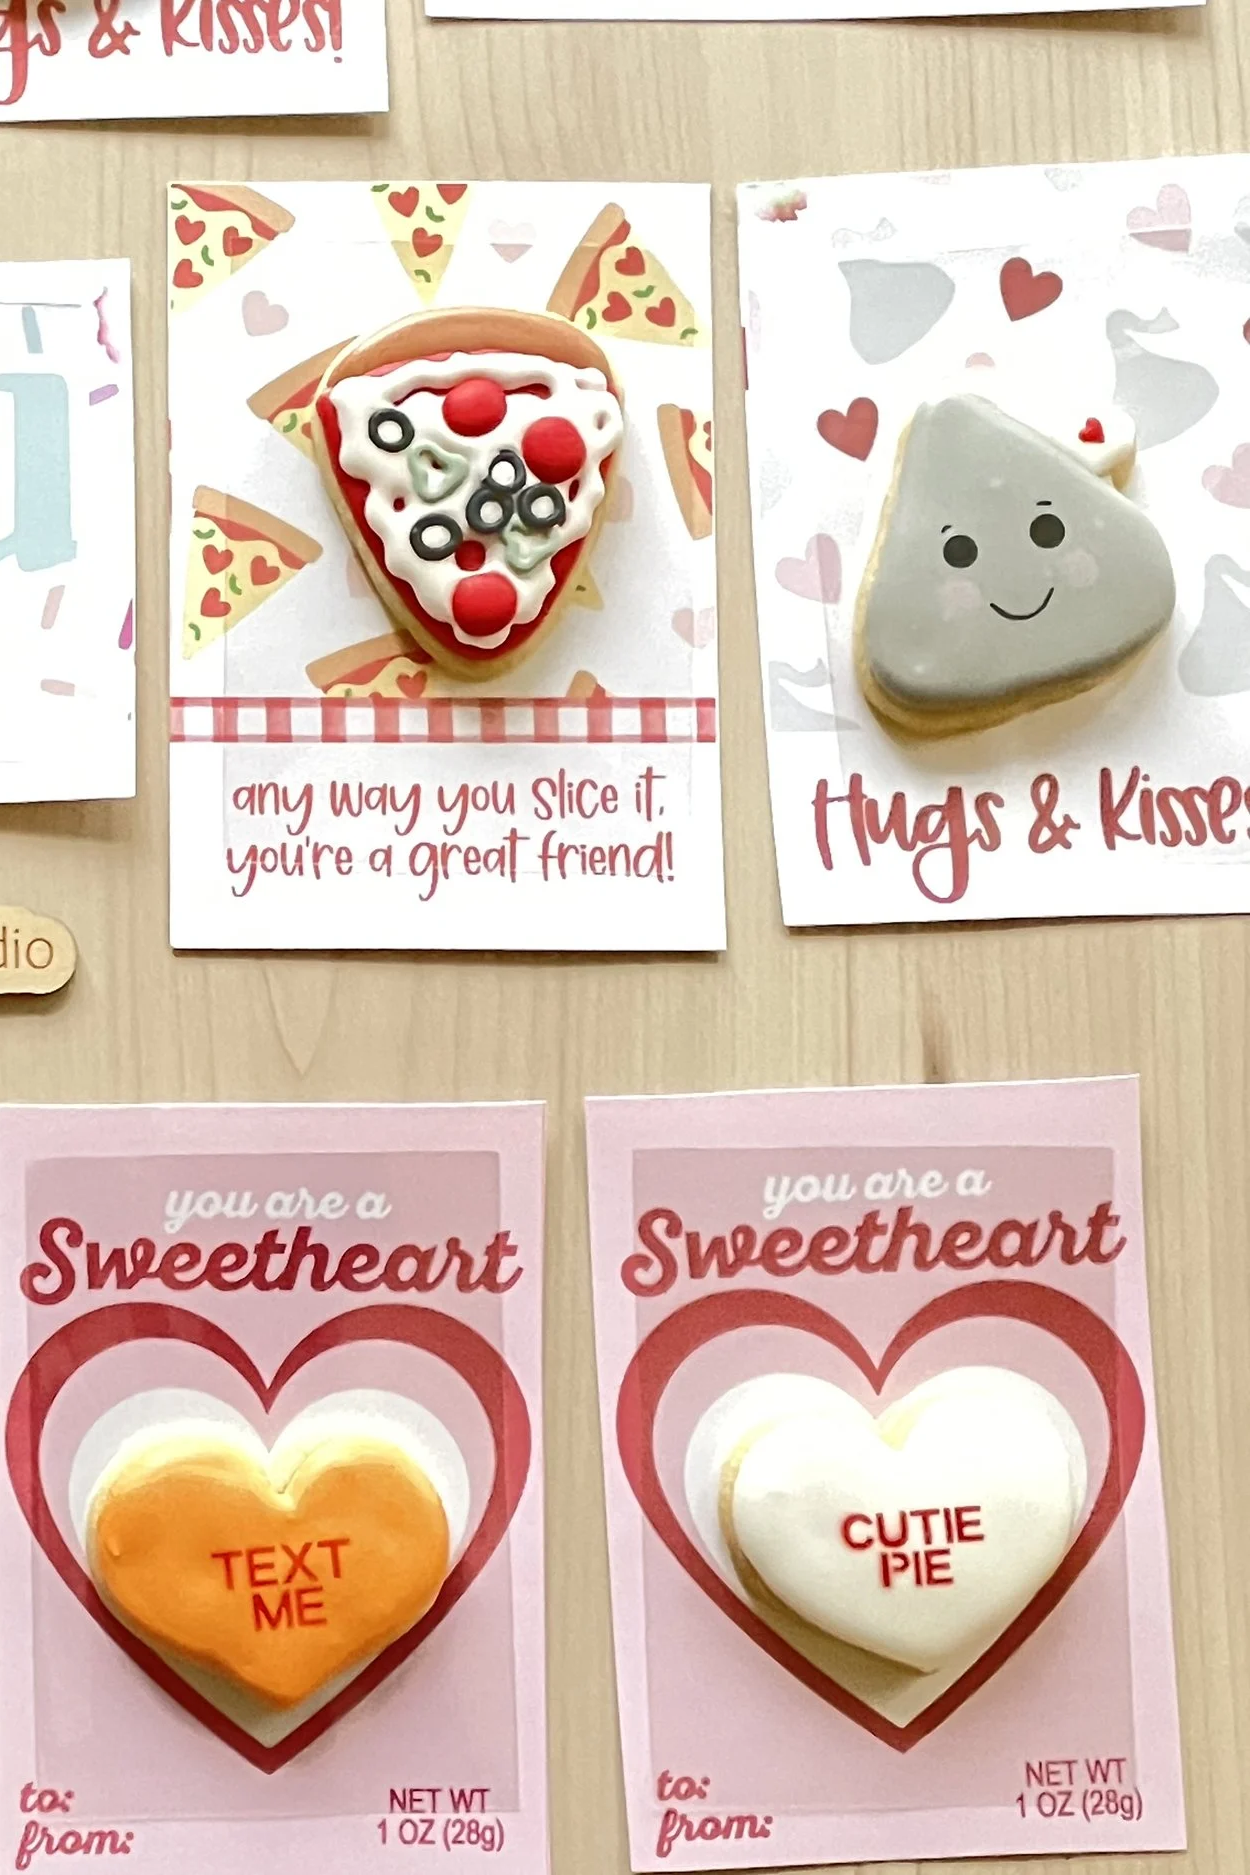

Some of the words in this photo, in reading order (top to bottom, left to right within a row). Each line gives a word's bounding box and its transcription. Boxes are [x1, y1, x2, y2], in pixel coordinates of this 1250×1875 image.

[88, 0, 141, 59] &
[159, 0, 344, 64] Kisses!
[233, 780, 313, 835] any
[330, 780, 421, 836] way
[438, 780, 515, 836] you
[811, 773, 1004, 904] Hugs
[1028, 773, 1080, 853] &
[1100, 766, 1250, 850] Kisse
[226, 836, 352, 897] you're
[369, 845, 393, 877] a
[409, 827, 530, 901] great
[537, 830, 675, 883] friend!
[164, 1188, 258, 1234] you
[264, 1187, 350, 1220] are
[356, 1188, 392, 1220] a
[761, 1170, 856, 1220] you
[864, 1167, 950, 1201] are
[956, 1167, 993, 1198] a
[19, 1216, 524, 1306] Sweetheart
[620, 1201, 1127, 1298] Sweetheart
[841, 1505, 985, 1550] CUTIE
[210, 1538, 351, 1590] TEXT
[880, 1548, 954, 1588] PIE
[252, 1586, 328, 1632] ME
[656, 1769, 712, 1802] to:
[1025, 1759, 1078, 1787] NET
[1084, 1758, 1128, 1784] WT
[19, 1782, 74, 1815] to:
[389, 1788, 442, 1814] NET
[448, 1788, 491, 1813] WT
[1016, 1794, 1026, 1819] 1
[1035, 1790, 1075, 1818] OZ
[1082, 1787, 1144, 1823] (28g)
[14, 1820, 135, 1871] from:
[377, 1821, 387, 1846] 1
[398, 1819, 436, 1846] OZ
[443, 1817, 505, 1853] (28g)
[655, 1808, 774, 1859] from:
